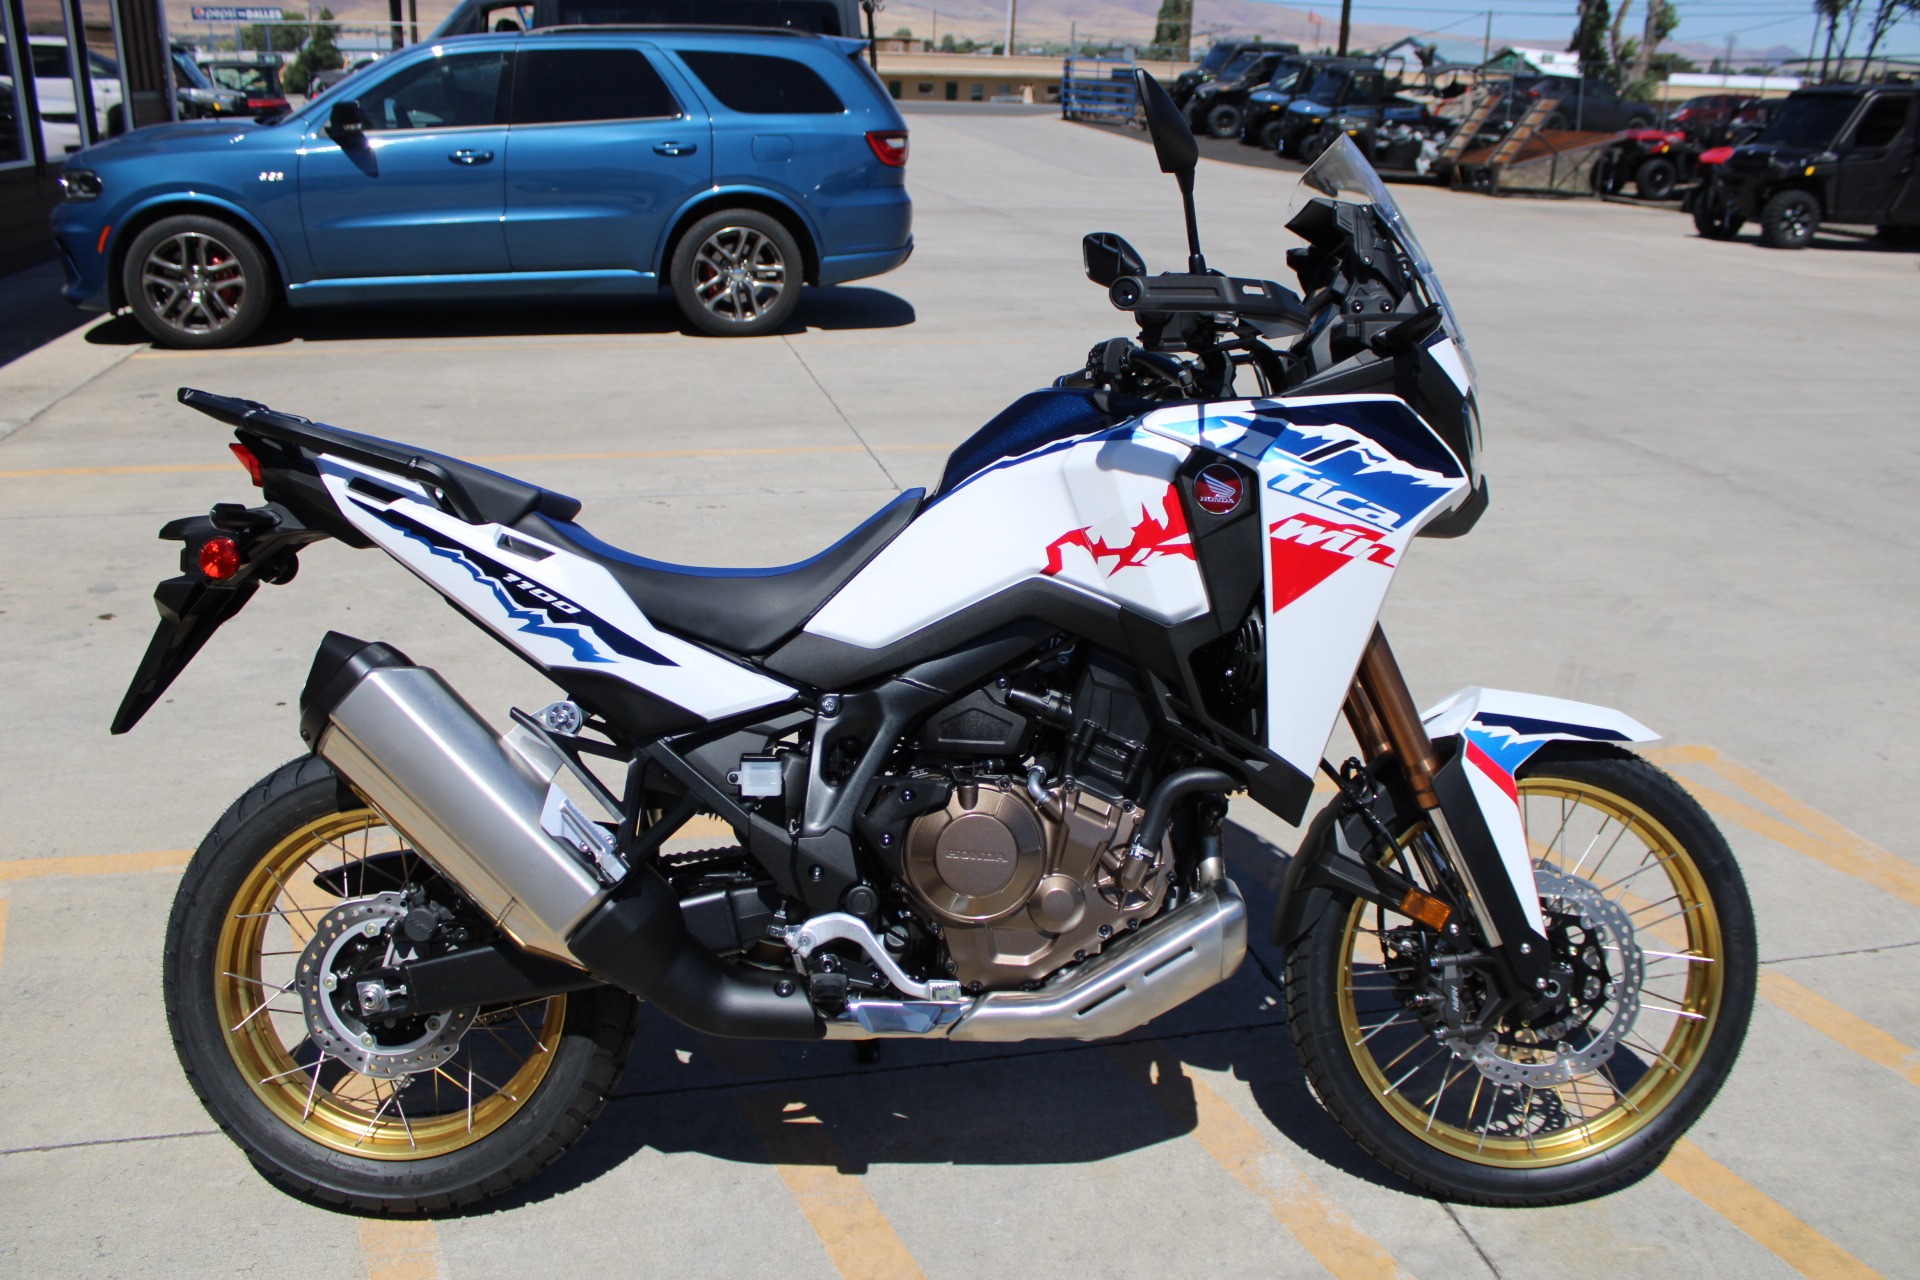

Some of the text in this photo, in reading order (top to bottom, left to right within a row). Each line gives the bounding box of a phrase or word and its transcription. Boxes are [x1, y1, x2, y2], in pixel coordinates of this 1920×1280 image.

[1199, 495, 1236, 504] HONDA
[503, 573, 581, 615] 1100
[944, 850, 1009, 863] HONDA
